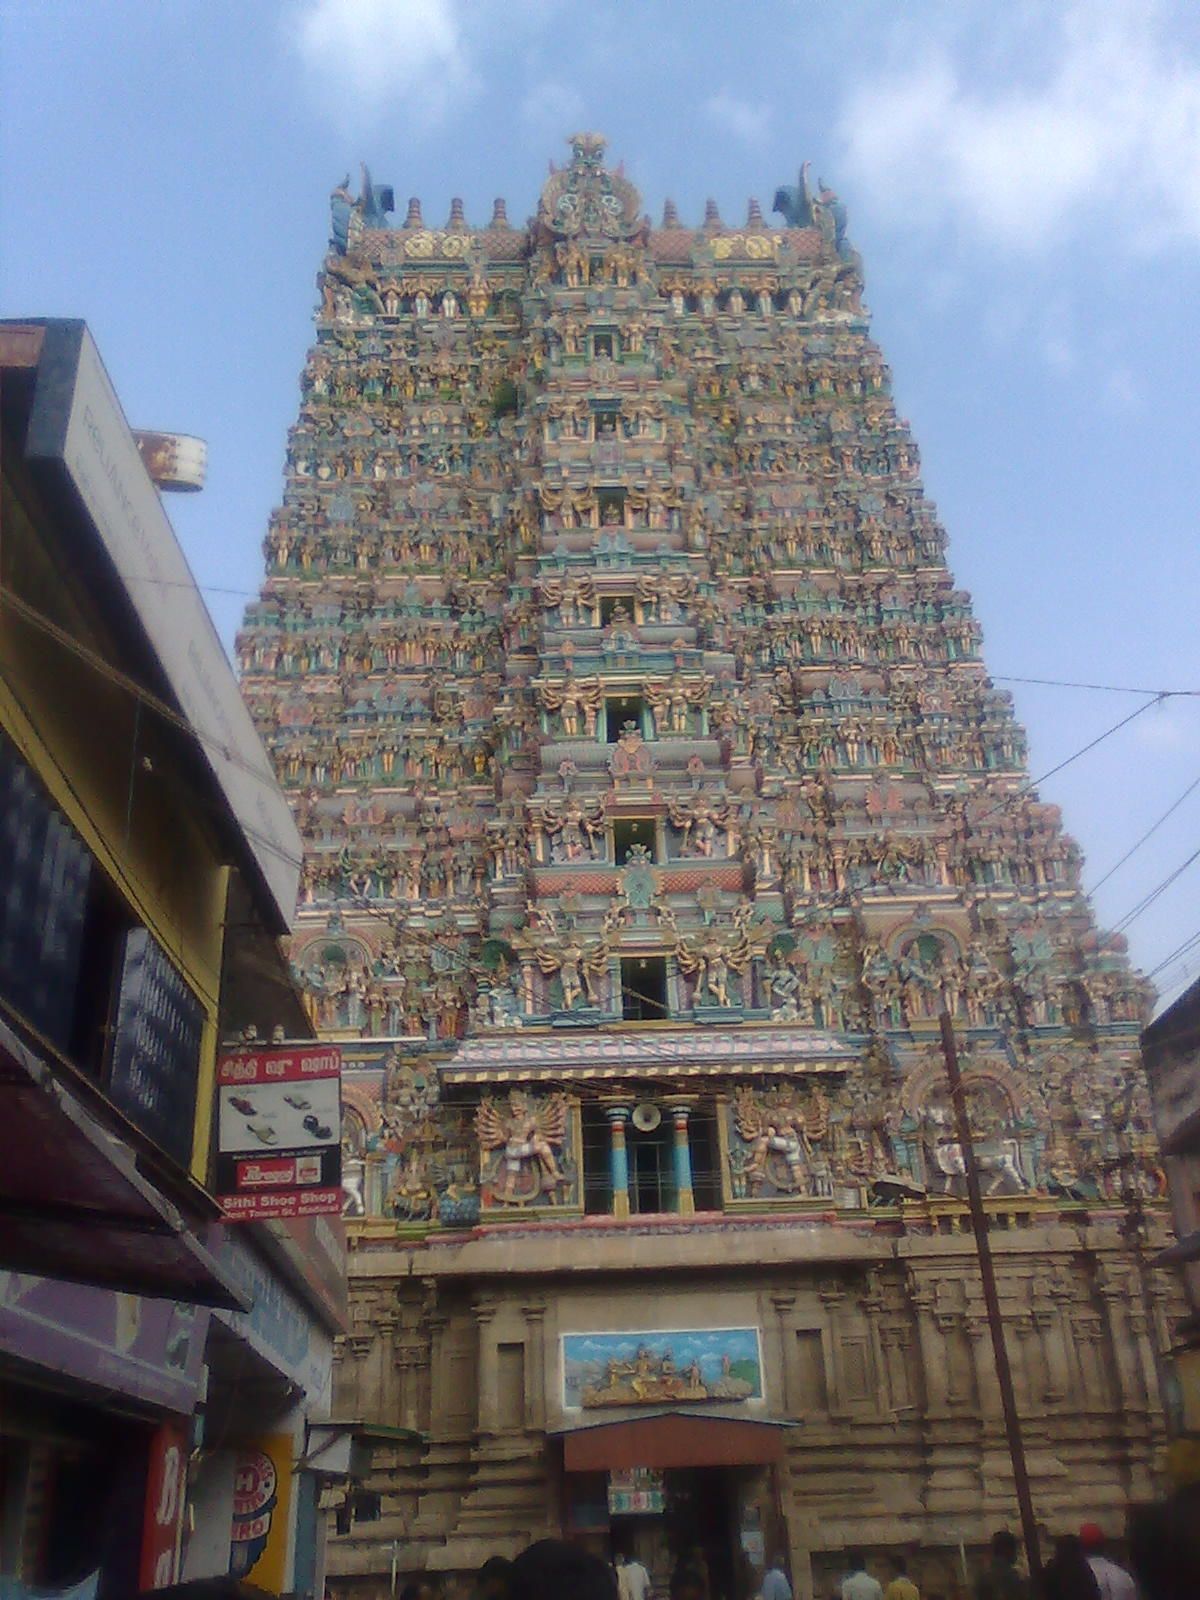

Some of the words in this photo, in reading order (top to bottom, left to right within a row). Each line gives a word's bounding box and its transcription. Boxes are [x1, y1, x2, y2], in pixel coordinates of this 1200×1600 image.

[223, 1195, 256, 1209] Sithi
[260, 1194, 296, 1207] Shoe
[301, 1192, 336, 1205] Shop
